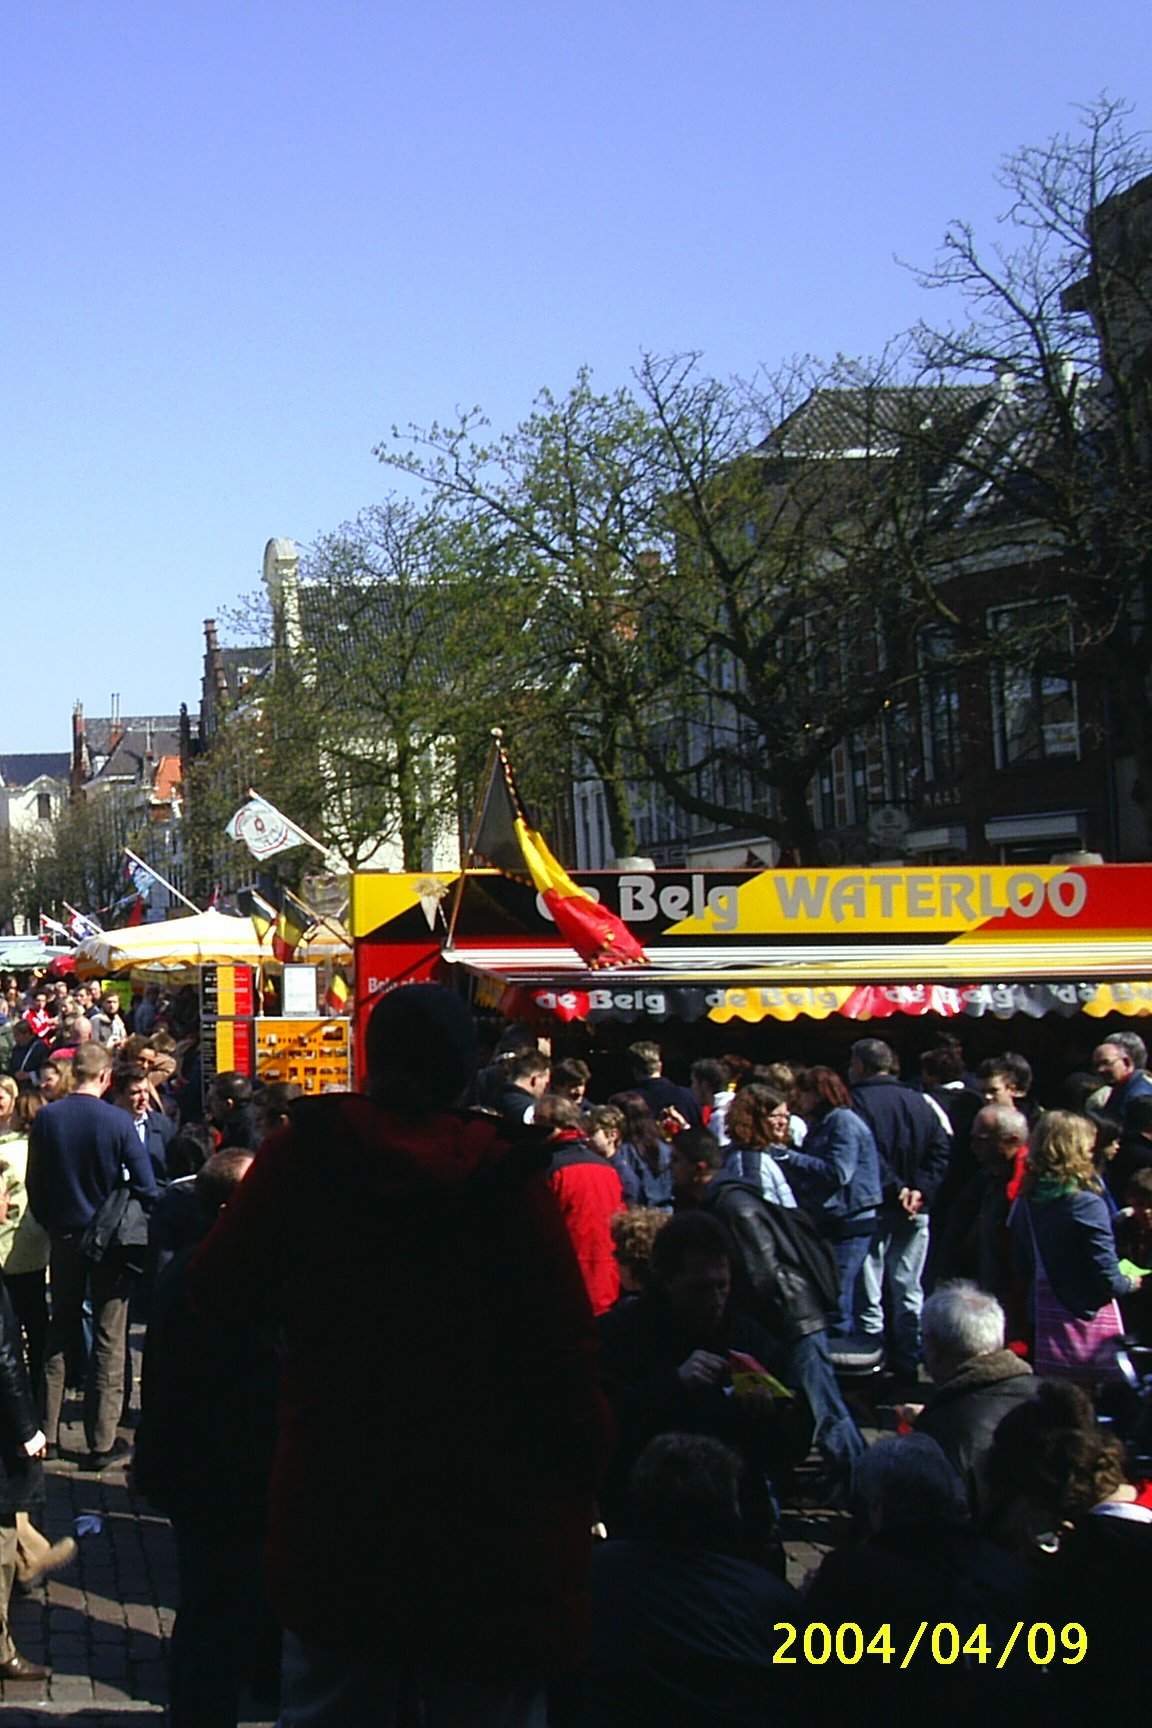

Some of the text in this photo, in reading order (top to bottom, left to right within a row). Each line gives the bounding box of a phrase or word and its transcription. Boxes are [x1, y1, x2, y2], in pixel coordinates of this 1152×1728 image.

[618, 874, 739, 931] Belg
[773, 871, 1087, 923] WATERLOO
[535, 989, 666, 1014] de Belg
[705, 986, 838, 1010] de Belg
